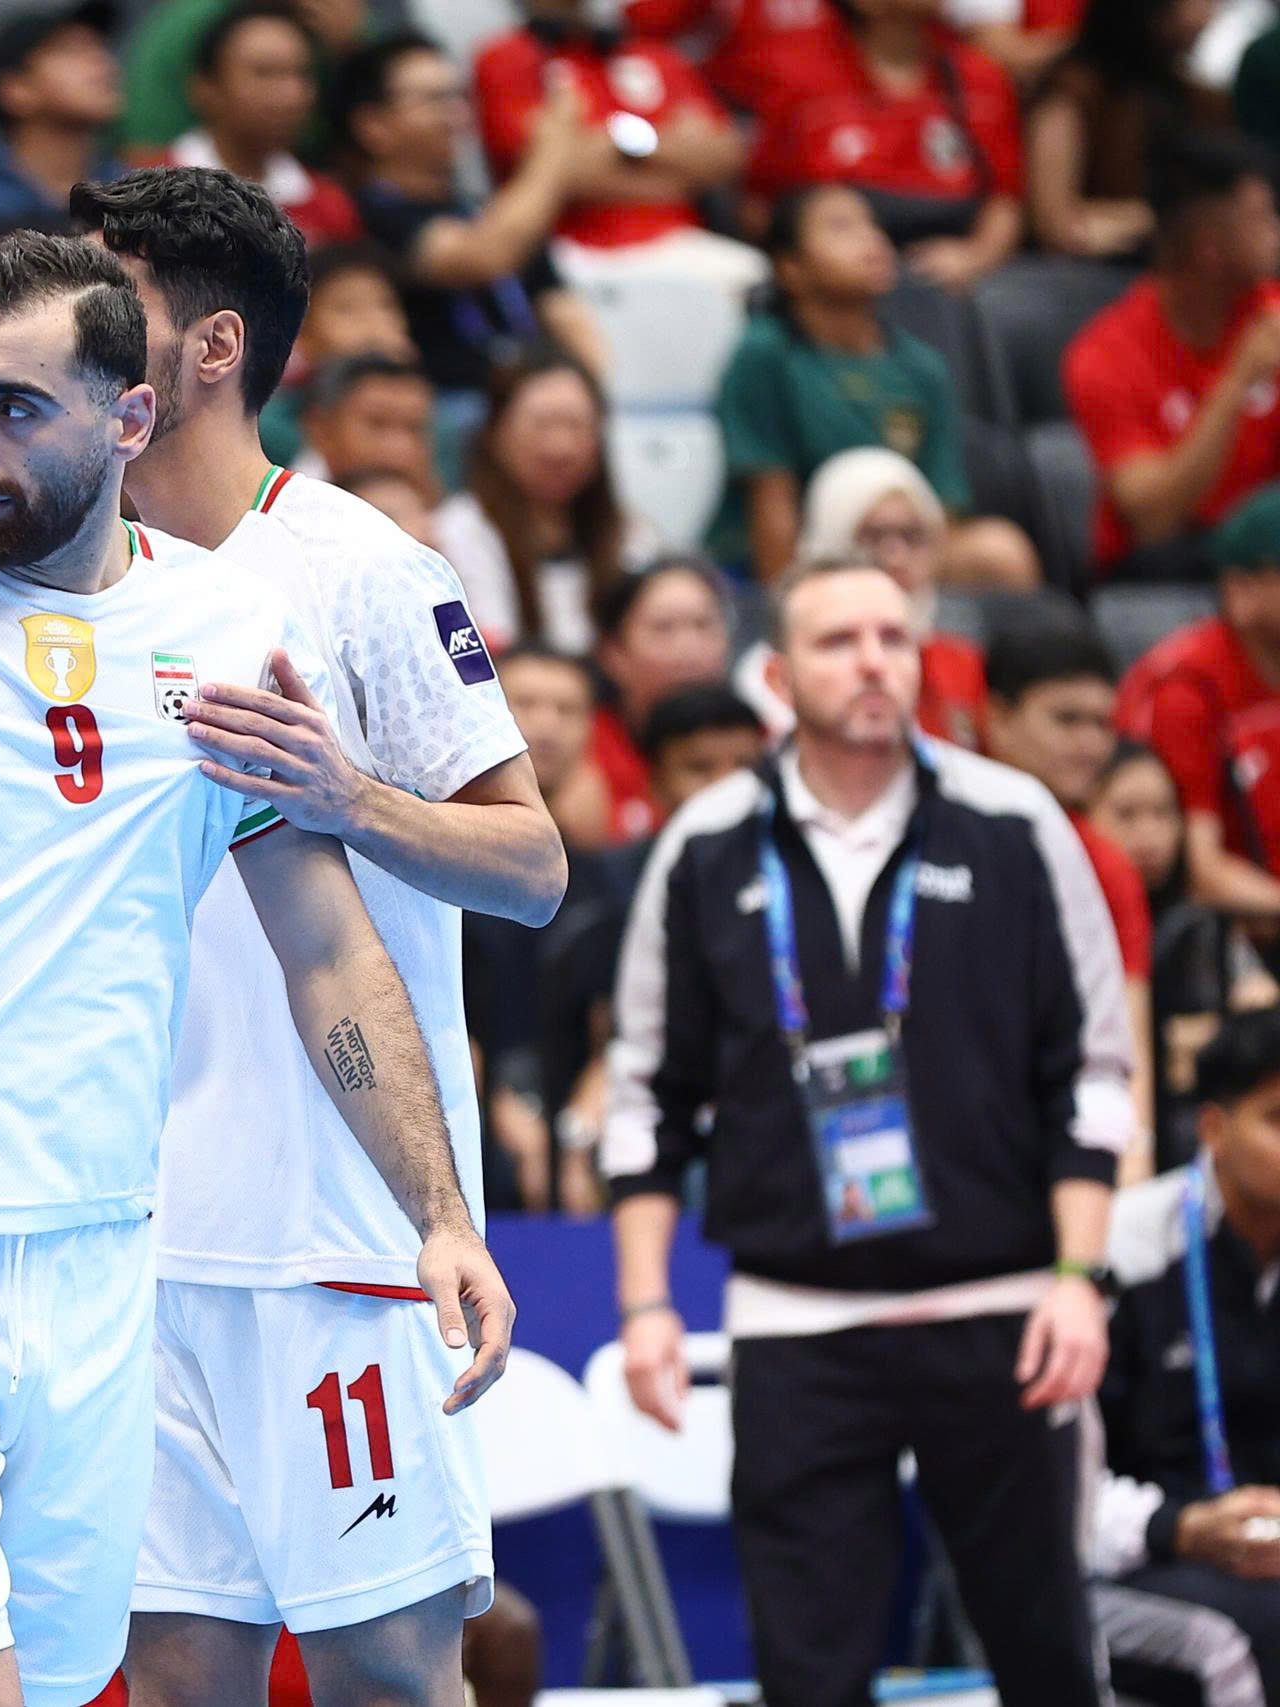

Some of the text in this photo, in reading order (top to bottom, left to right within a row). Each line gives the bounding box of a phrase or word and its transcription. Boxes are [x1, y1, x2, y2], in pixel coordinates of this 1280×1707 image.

[449, 627, 479, 654] AFC
[46, 704, 104, 804] 9
[327, 1024, 363, 1092] WHEN?
[340, 1016, 377, 1090] IF NOT NOW
[306, 1364, 395, 1490] 11
